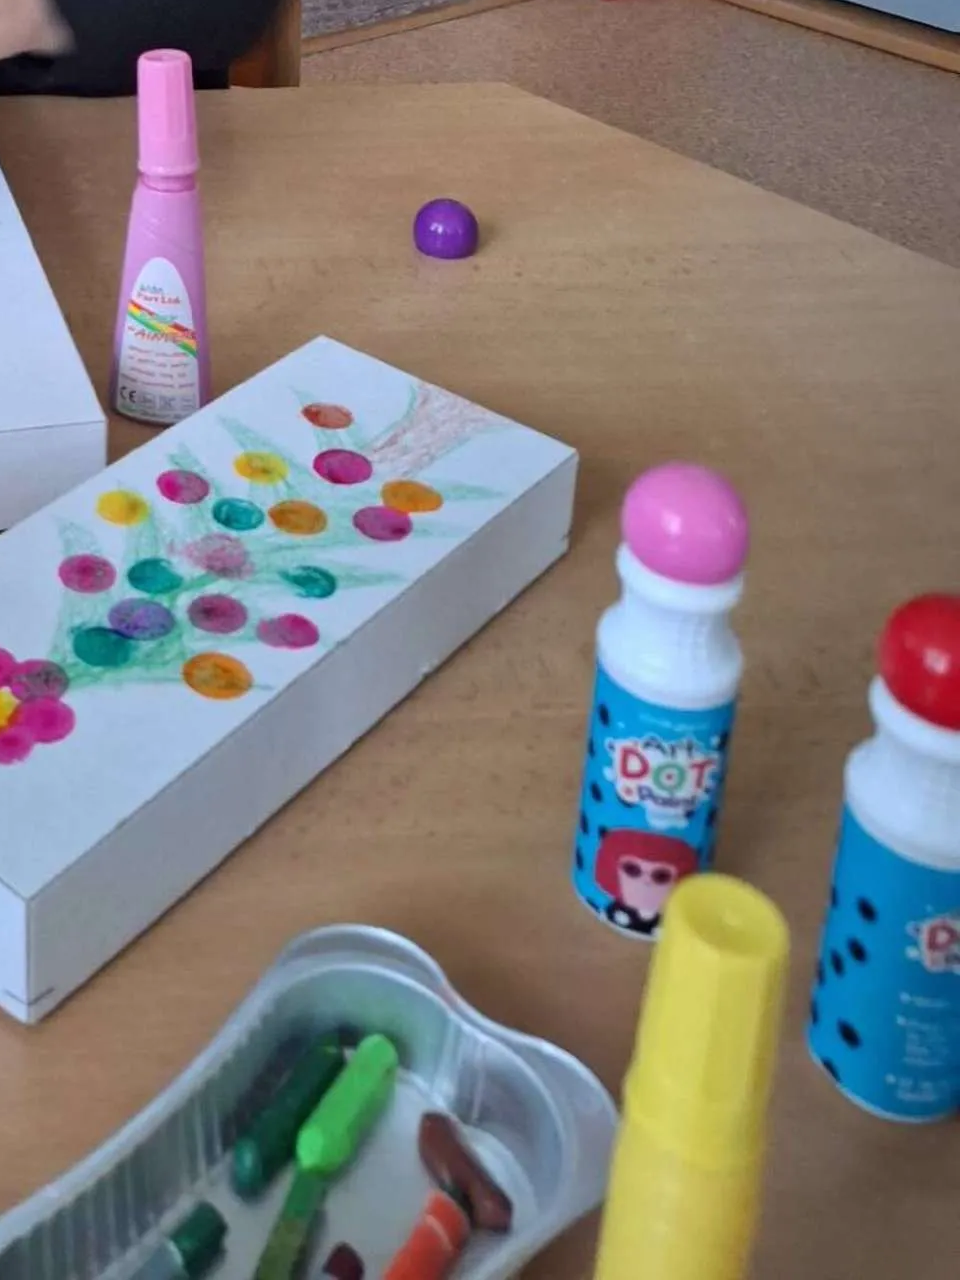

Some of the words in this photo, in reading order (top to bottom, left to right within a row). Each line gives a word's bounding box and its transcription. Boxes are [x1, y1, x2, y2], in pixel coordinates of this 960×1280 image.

[642, 735, 694, 758] Art
[620, 746, 716, 794] DOT
[638, 785, 697, 811] Paint
